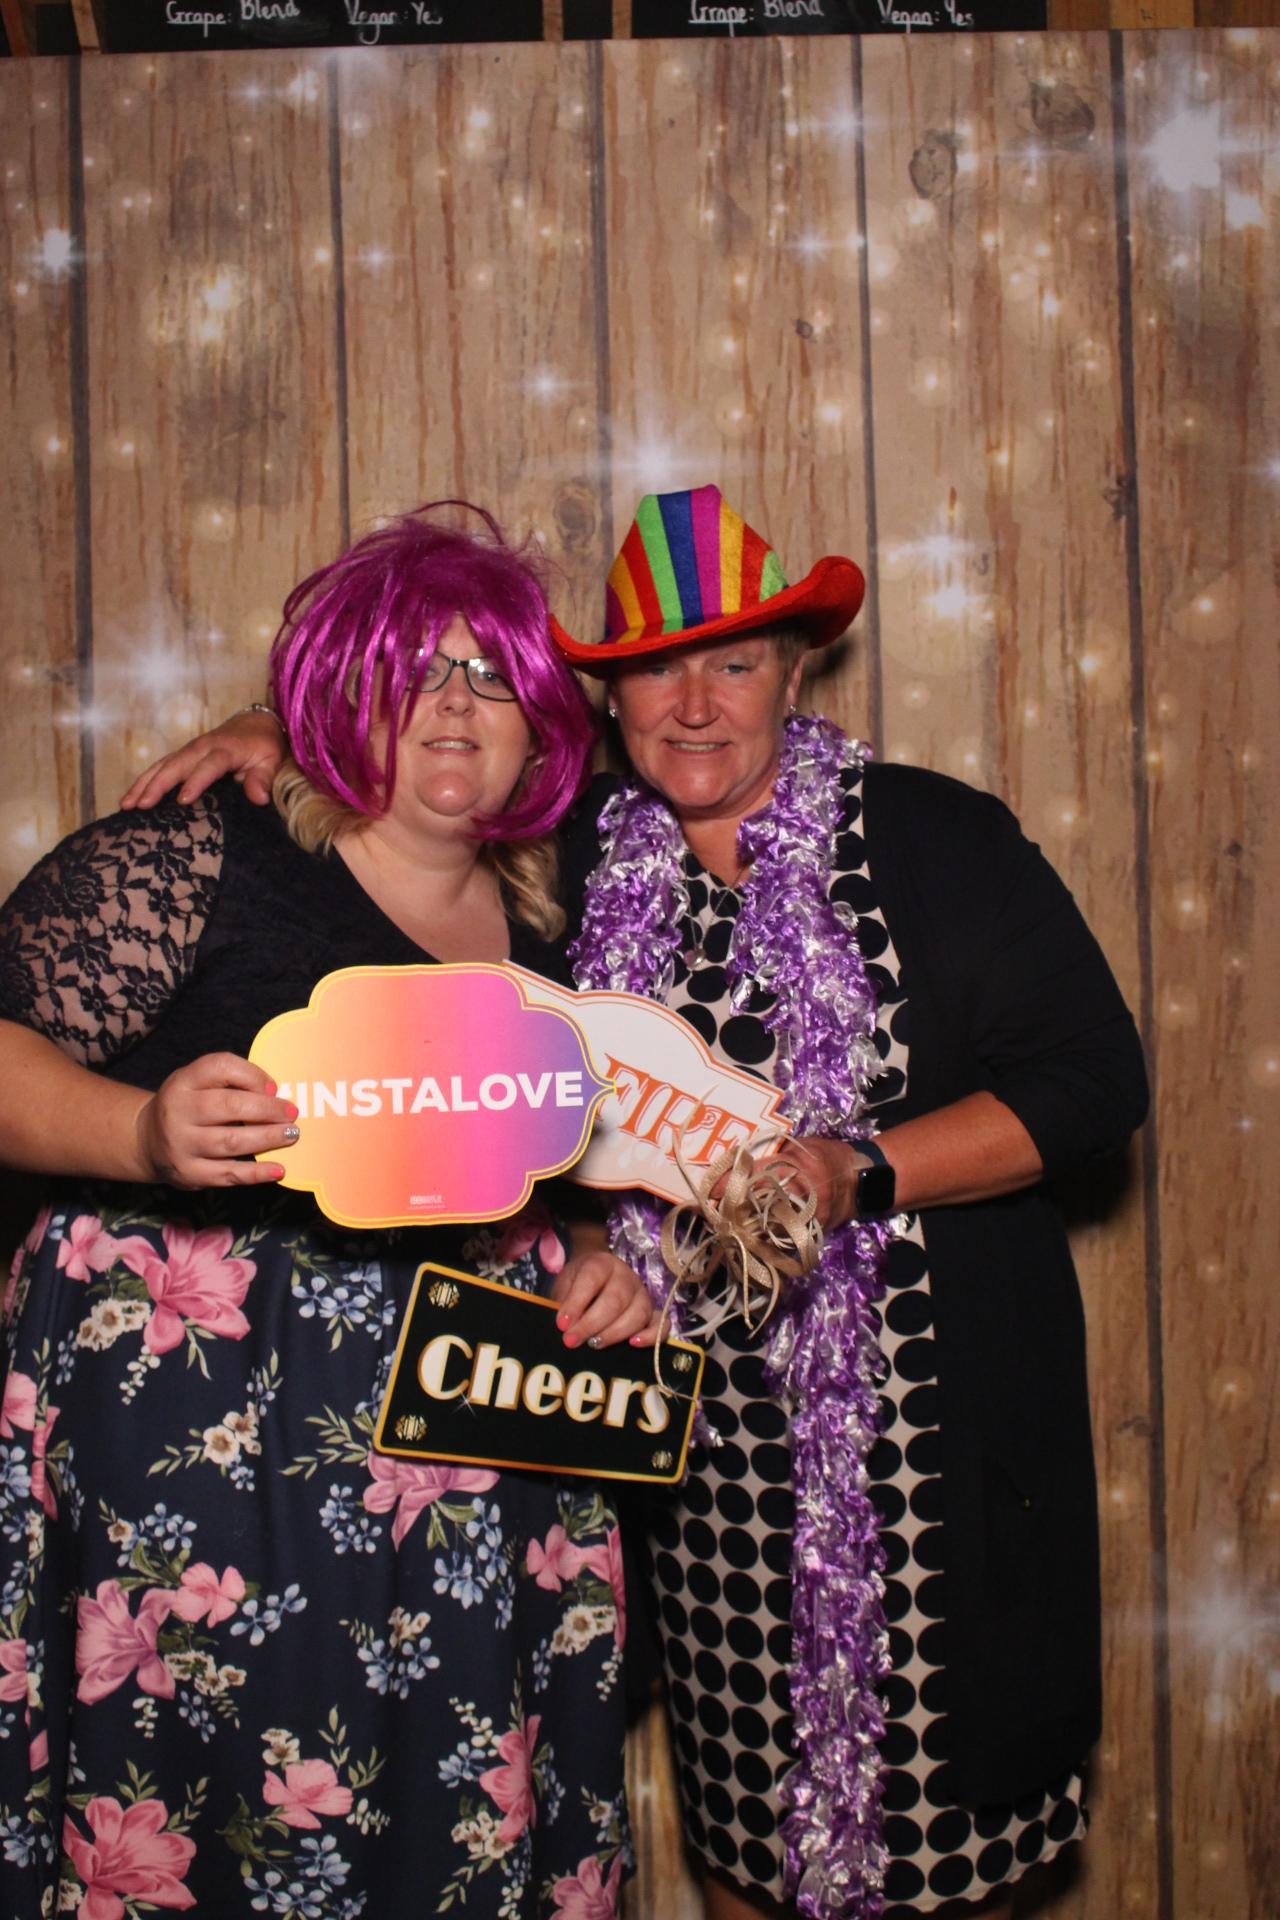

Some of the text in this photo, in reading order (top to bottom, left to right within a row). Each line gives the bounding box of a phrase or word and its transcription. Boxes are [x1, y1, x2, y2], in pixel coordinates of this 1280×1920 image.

[165, 1, 231, 38] Grape:
[241, 0, 300, 20] Blend
[763, 0, 825, 18] Blend
[943, 0, 975, 27] Yes
[417, 1334, 671, 1434] Cheers
